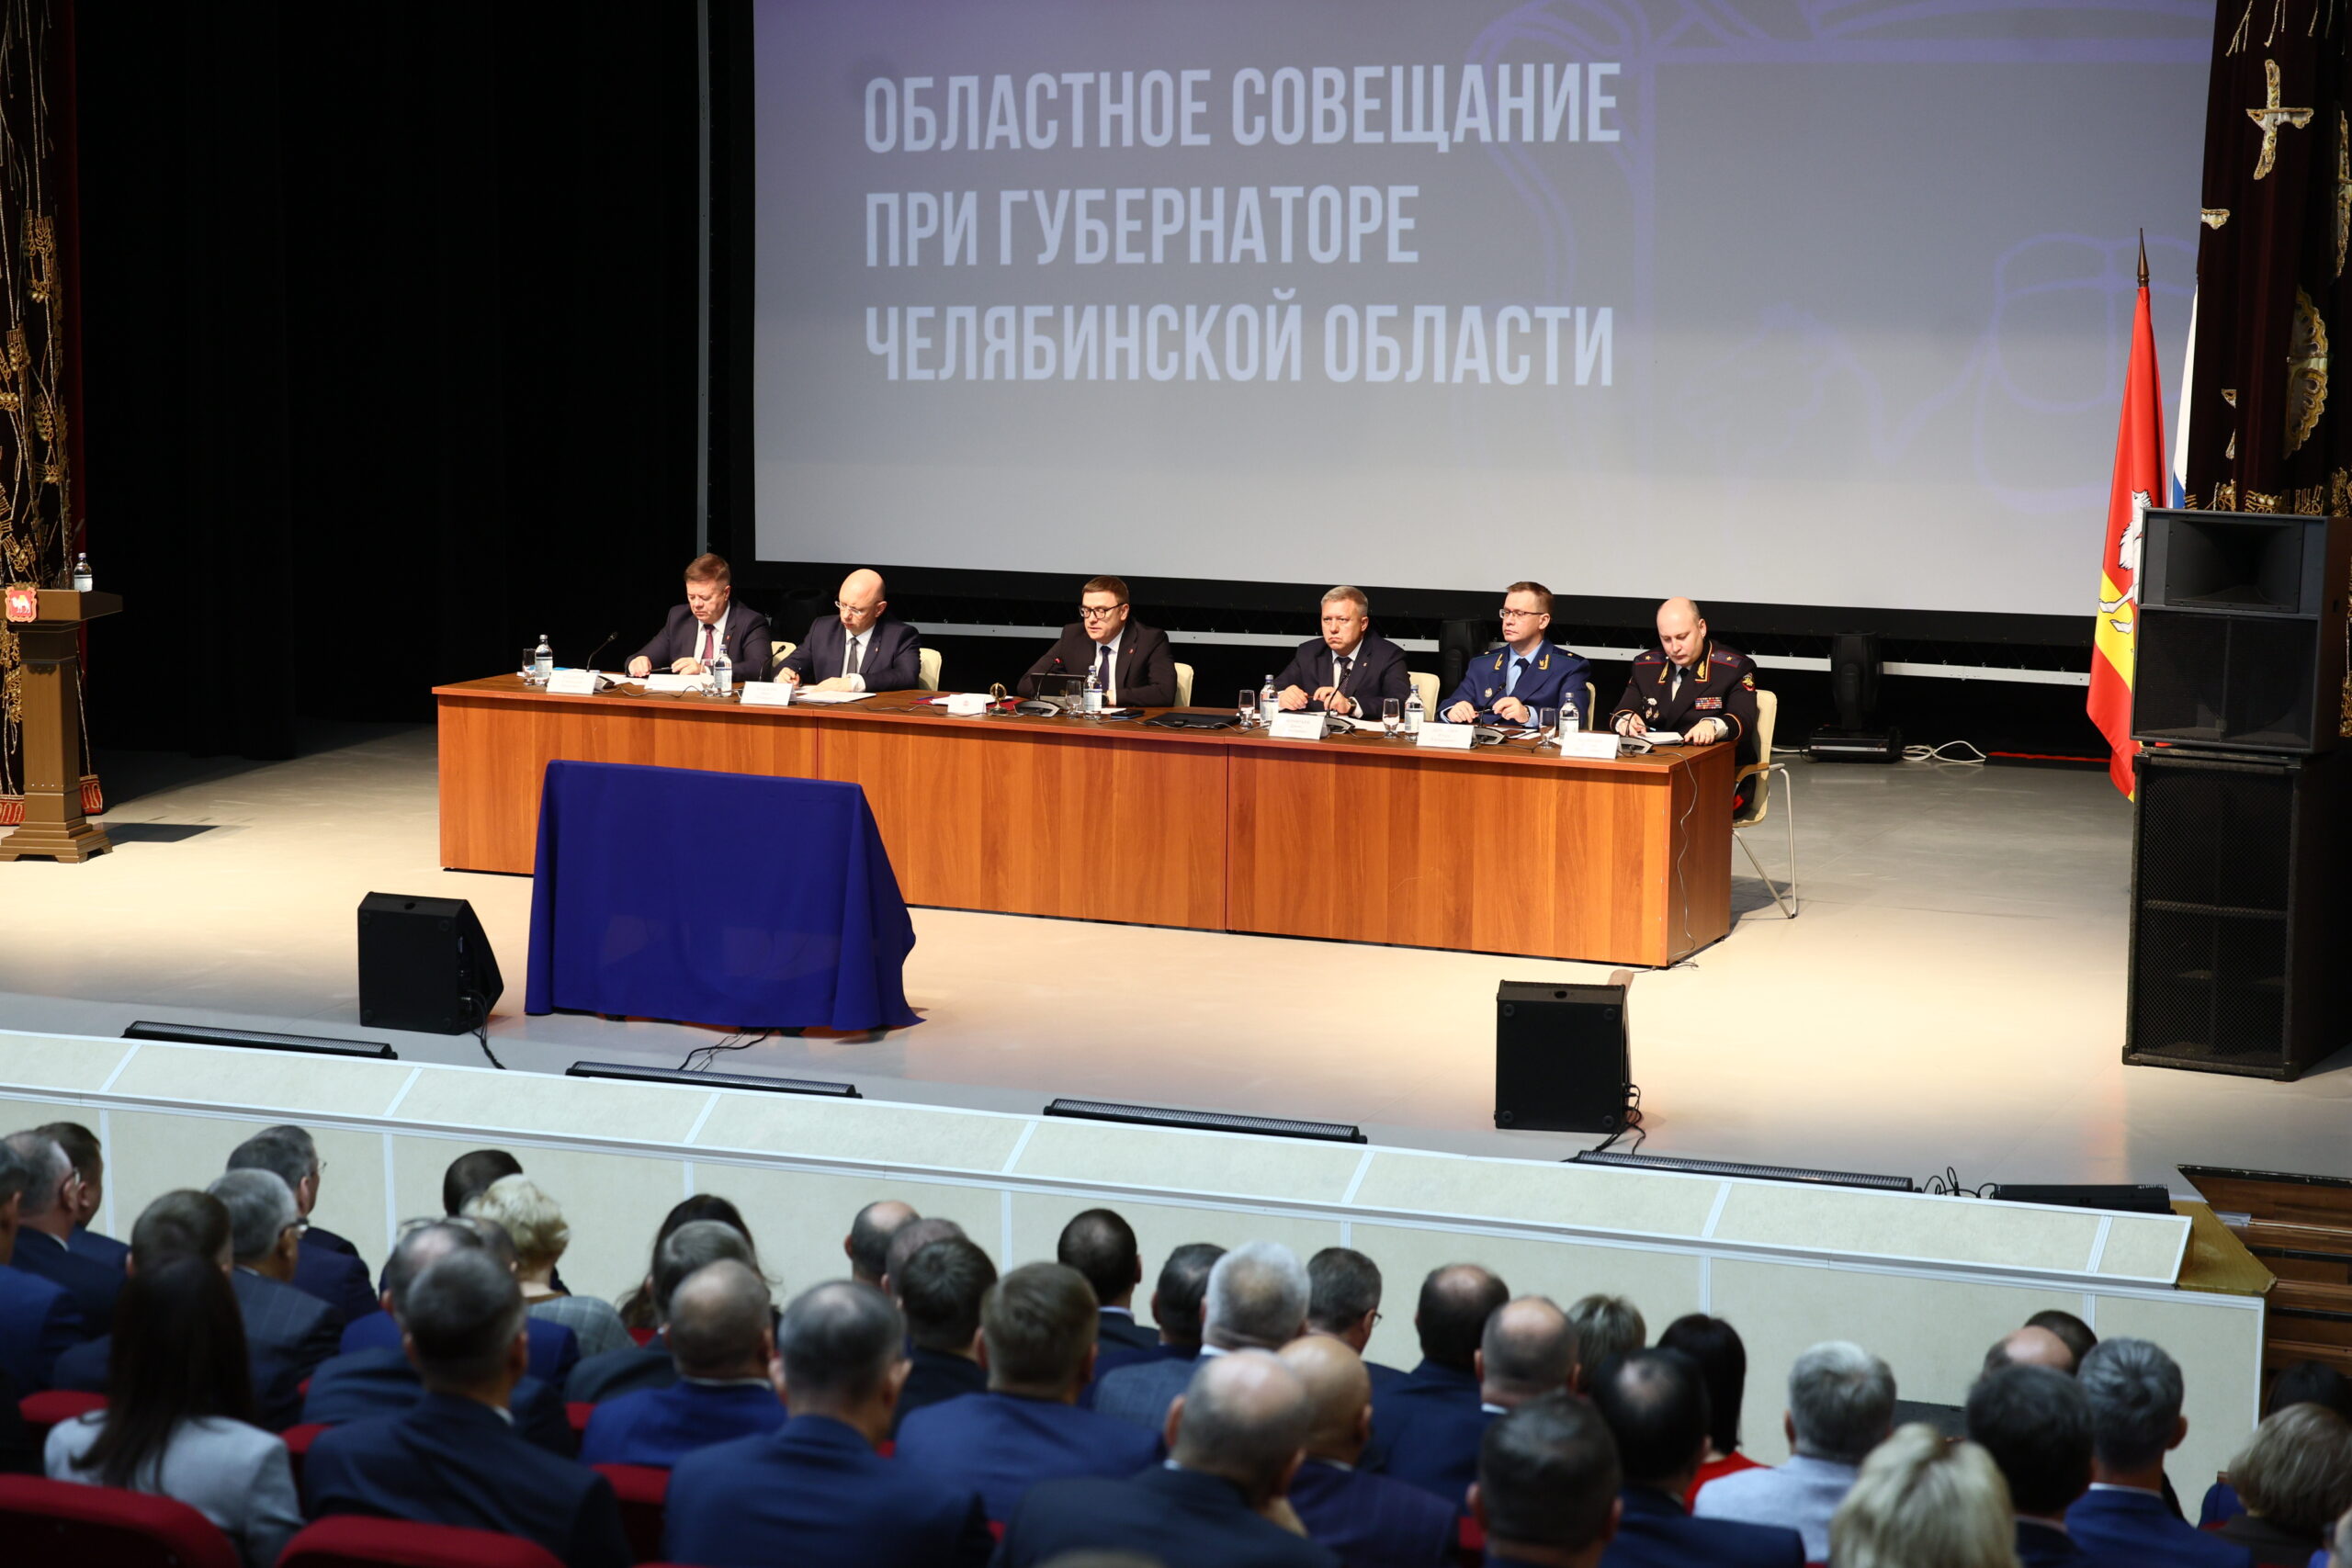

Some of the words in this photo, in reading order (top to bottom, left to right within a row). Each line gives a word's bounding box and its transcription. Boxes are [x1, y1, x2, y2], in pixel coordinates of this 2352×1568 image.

[865, 70, 1211, 152] ОБЛАСТНОЕ
[1232, 63, 1621, 152] СОВЕЩАНИЕ
[866, 192, 978, 266] ПРИ
[1001, 186, 1419, 265] ГУБЕРНАТОРЕ
[866, 288, 1301, 380] ЧЕЛЯБИНСКОЙ
[1325, 304, 1612, 385] ОБЛАСТИ
